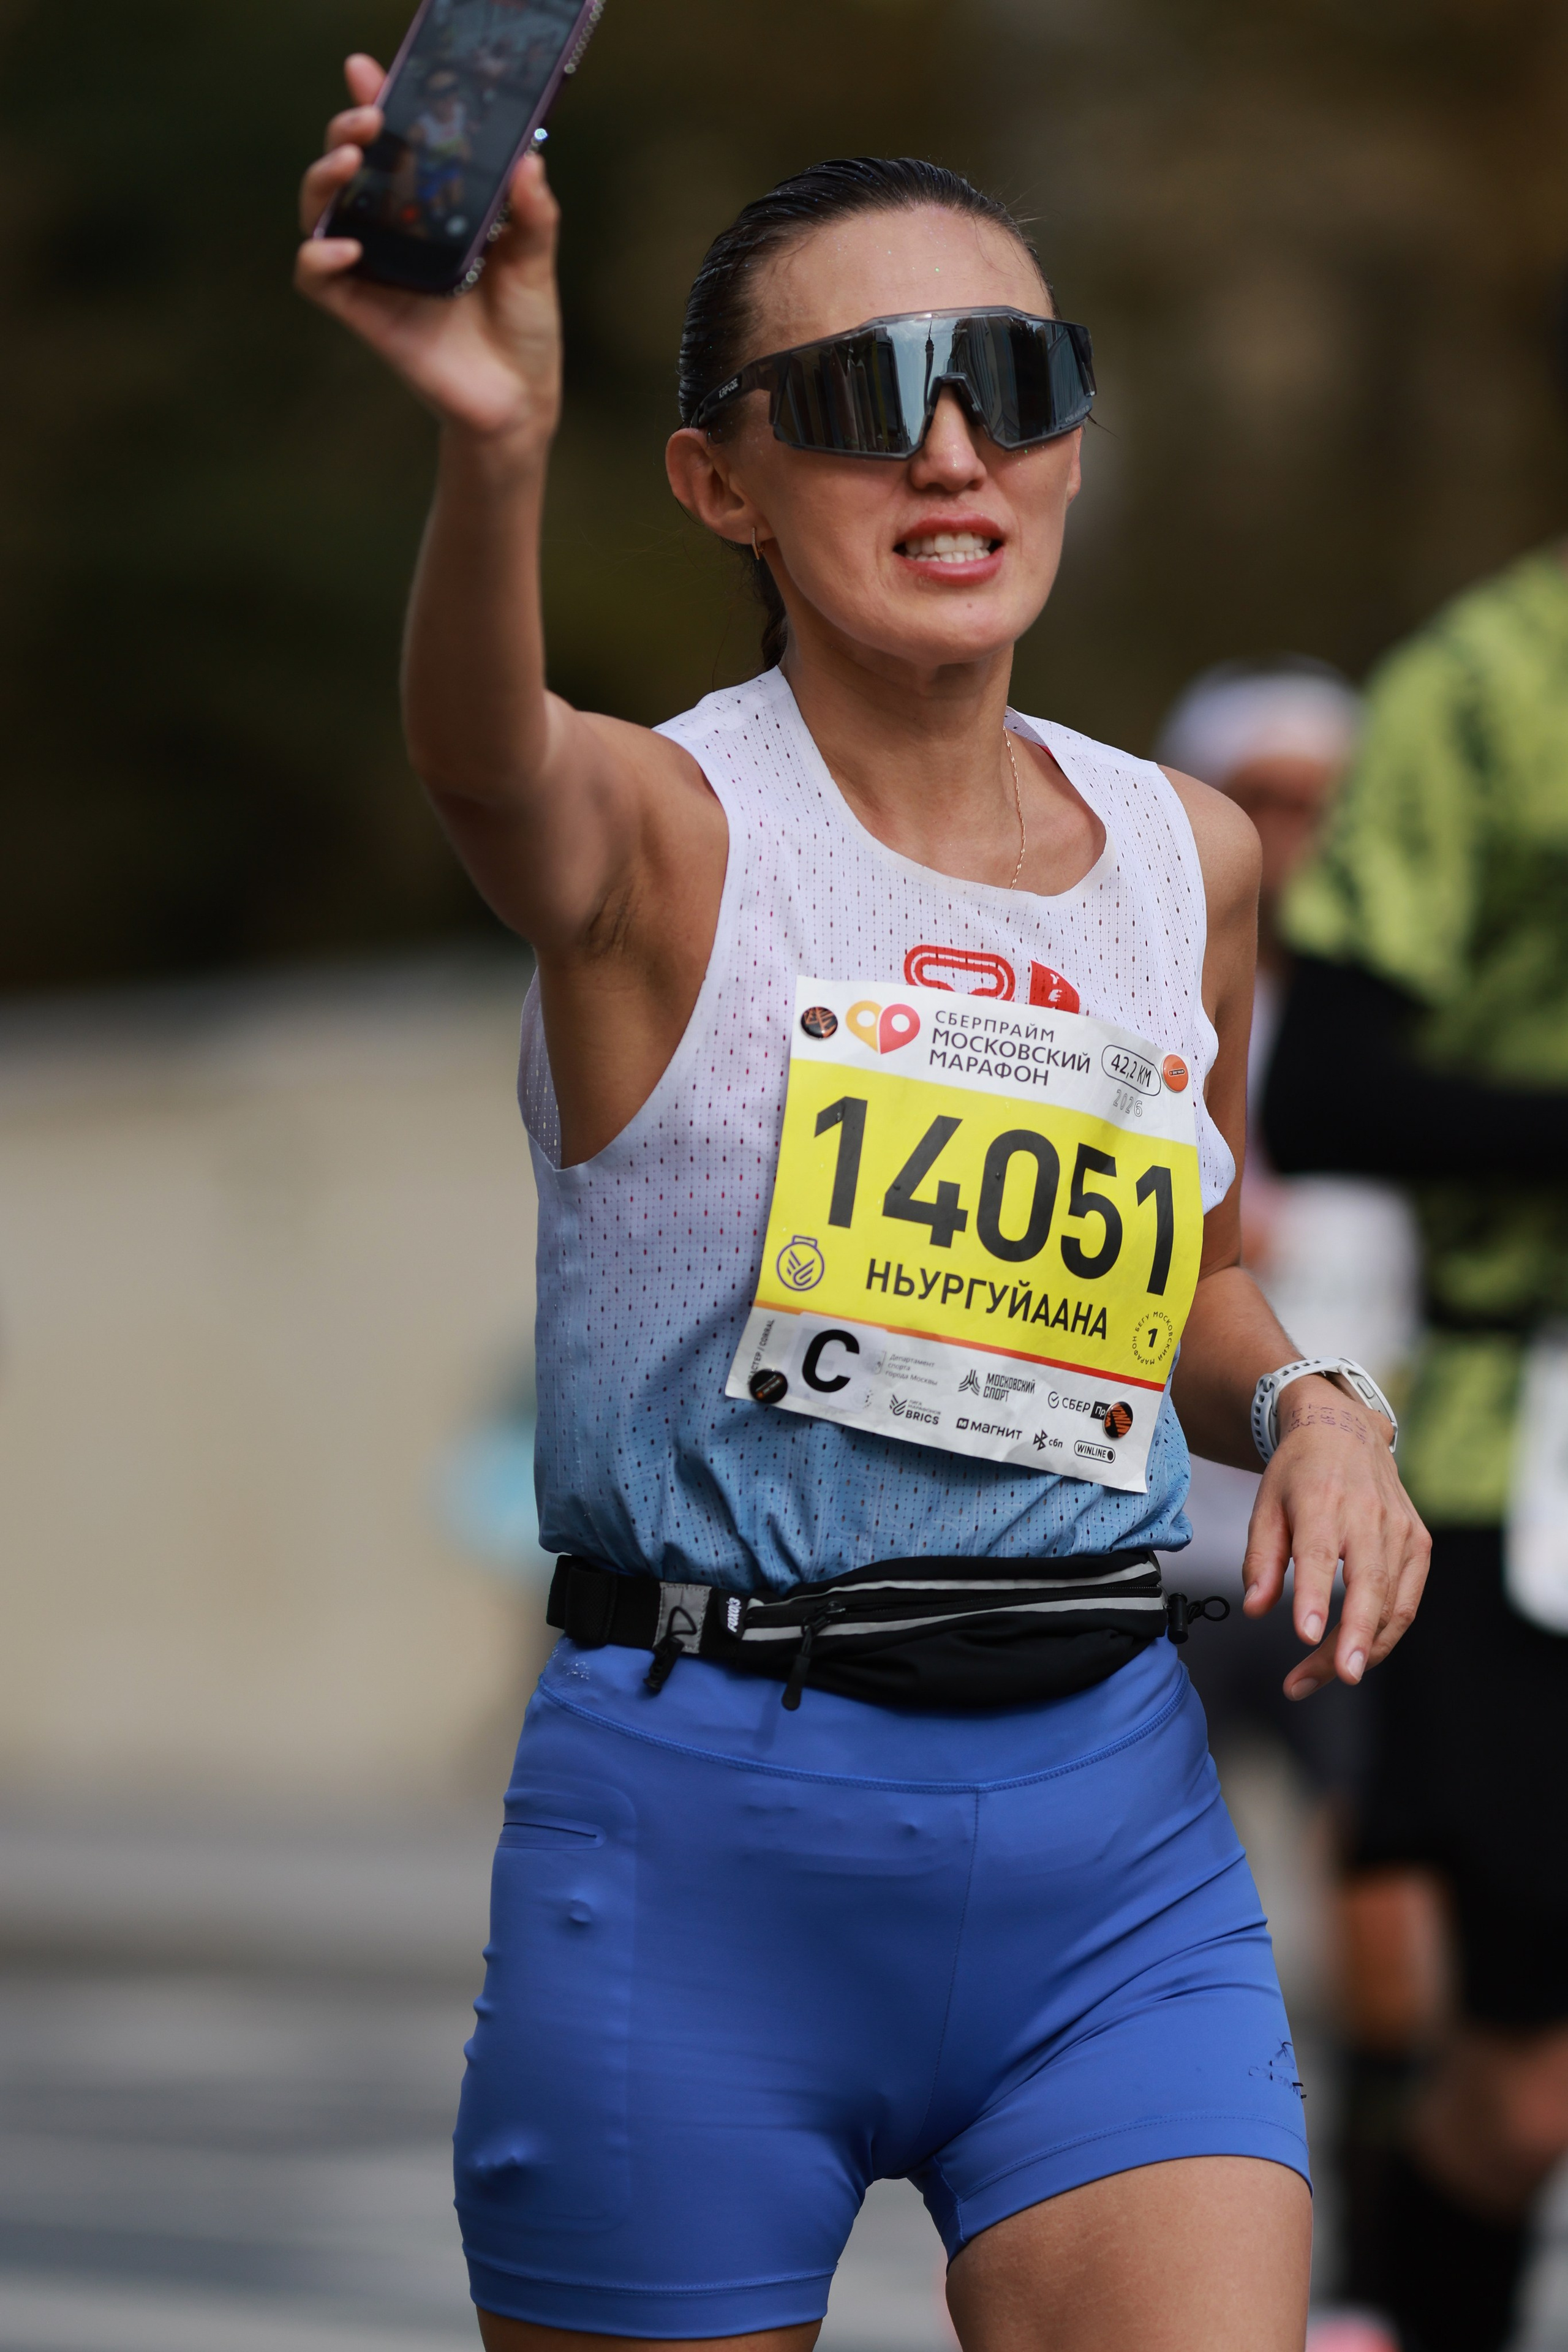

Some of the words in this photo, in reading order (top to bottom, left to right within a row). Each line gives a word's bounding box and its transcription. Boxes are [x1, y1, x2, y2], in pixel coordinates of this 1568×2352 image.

[935, 1010, 1055, 1042] СБЕРПРАЙМ
[932, 1028, 1090, 1074] МОСКОВСКИЙ
[929, 1049, 1049, 1086] МАРАФОН
[1111, 1054, 1138, 1079] 42,2
[1112, 1089, 1143, 1117] 2026
[813, 1095, 1174, 1297] 14051
[865, 1257, 1109, 1341] НЬУРГУЙААНА
[1134, 1313, 1149, 1332] БЕГУ
[1148, 1328, 1158, 1348] 1
[1153, 1311, 1173, 1361] МОСКОВСКИЙ
[889, 1354, 935, 1367] Департамент
[1132, 1336, 1155, 1365] МАРАФОН
[888, 1363, 911, 1371] спорта
[885, 1371, 908, 1381] города
[910, 1374, 938, 1386] Москвы
[986, 1373, 1035, 1394] МОСКОВСКИЙ
[983, 1386, 1009, 1402] СПОРТ
[1061, 1397, 1091, 1413] СБЕР
[905, 1410, 940, 1425] BRICS
[1077, 1444, 1107, 1458] WINLINE
